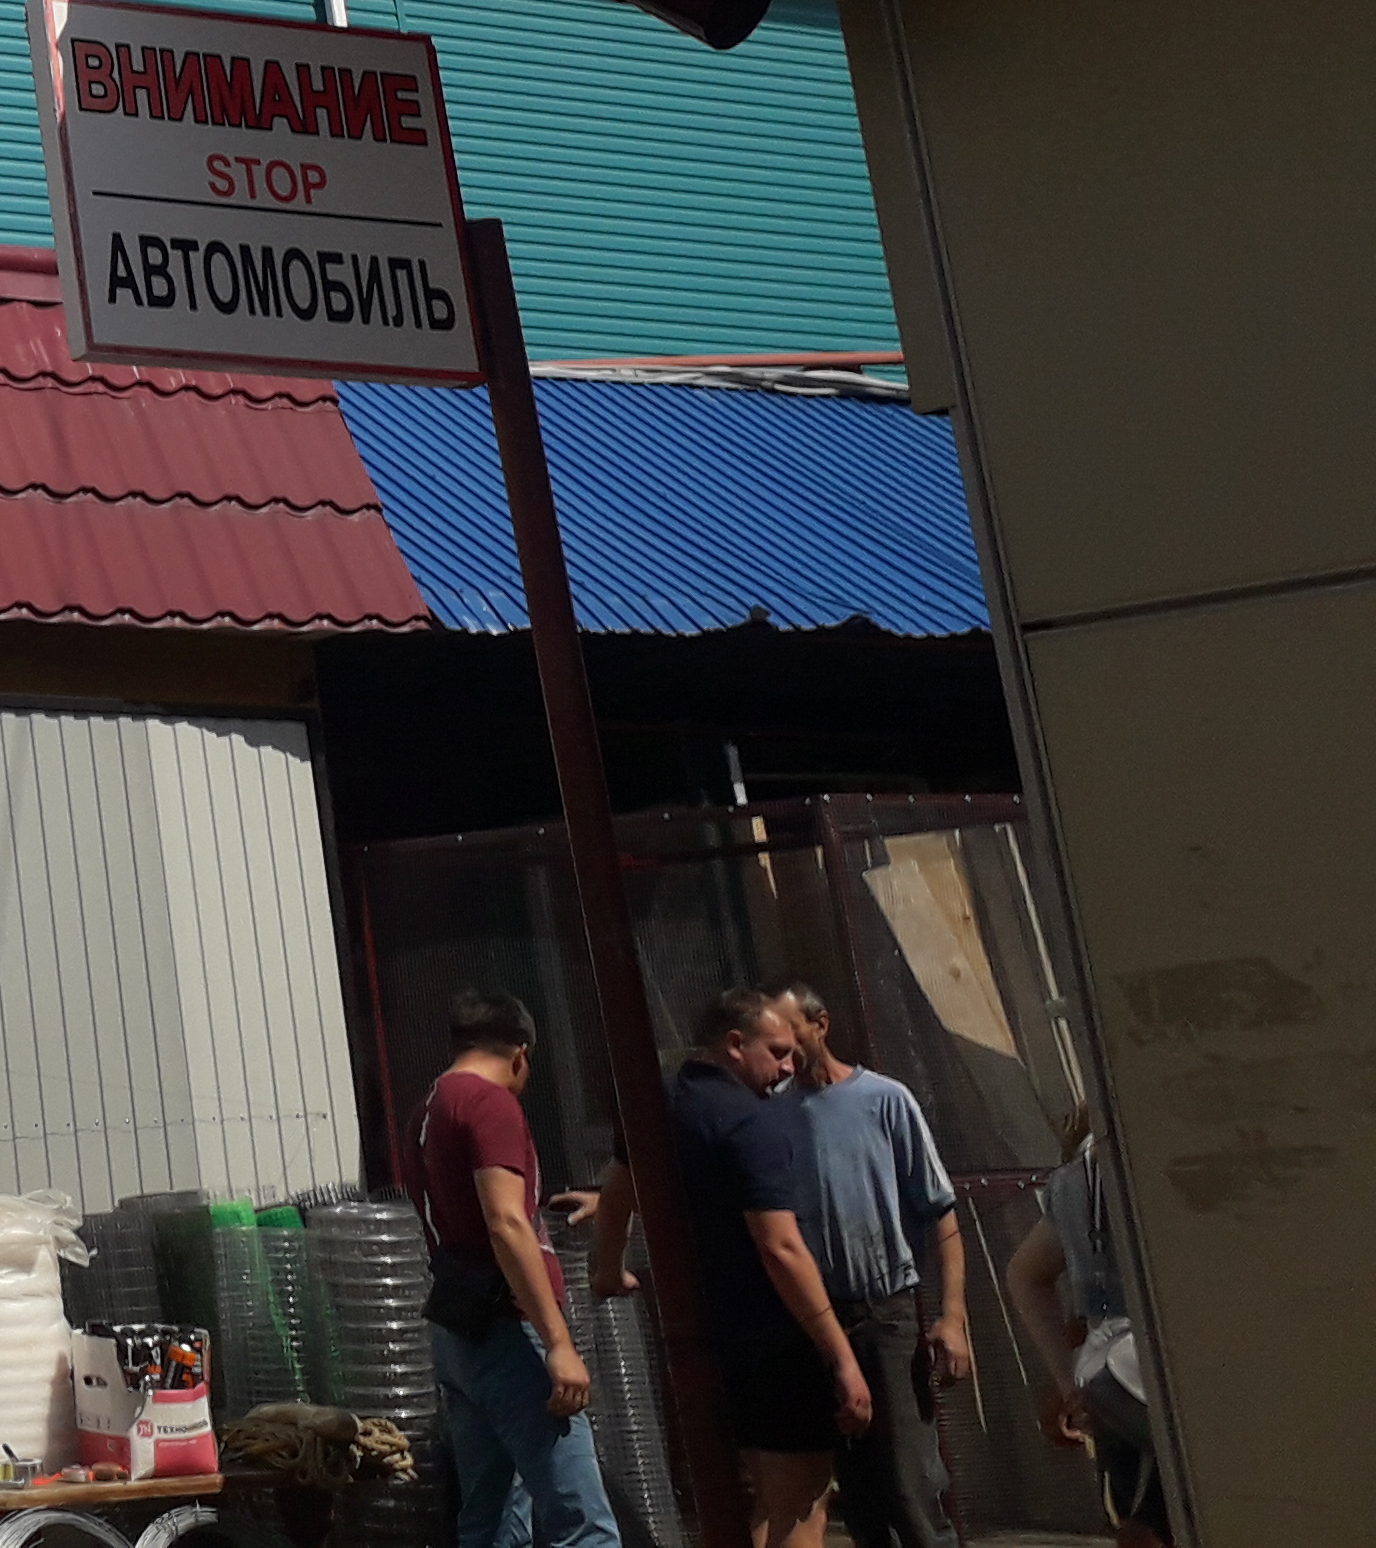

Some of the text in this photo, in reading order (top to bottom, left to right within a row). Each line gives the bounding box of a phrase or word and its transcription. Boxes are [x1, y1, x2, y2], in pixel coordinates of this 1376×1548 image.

[70, 37, 428, 145] ВНИМАНИЕ
[205, 153, 328, 205] STOP
[107, 231, 456, 331] АВТОМОБИЛЬ
